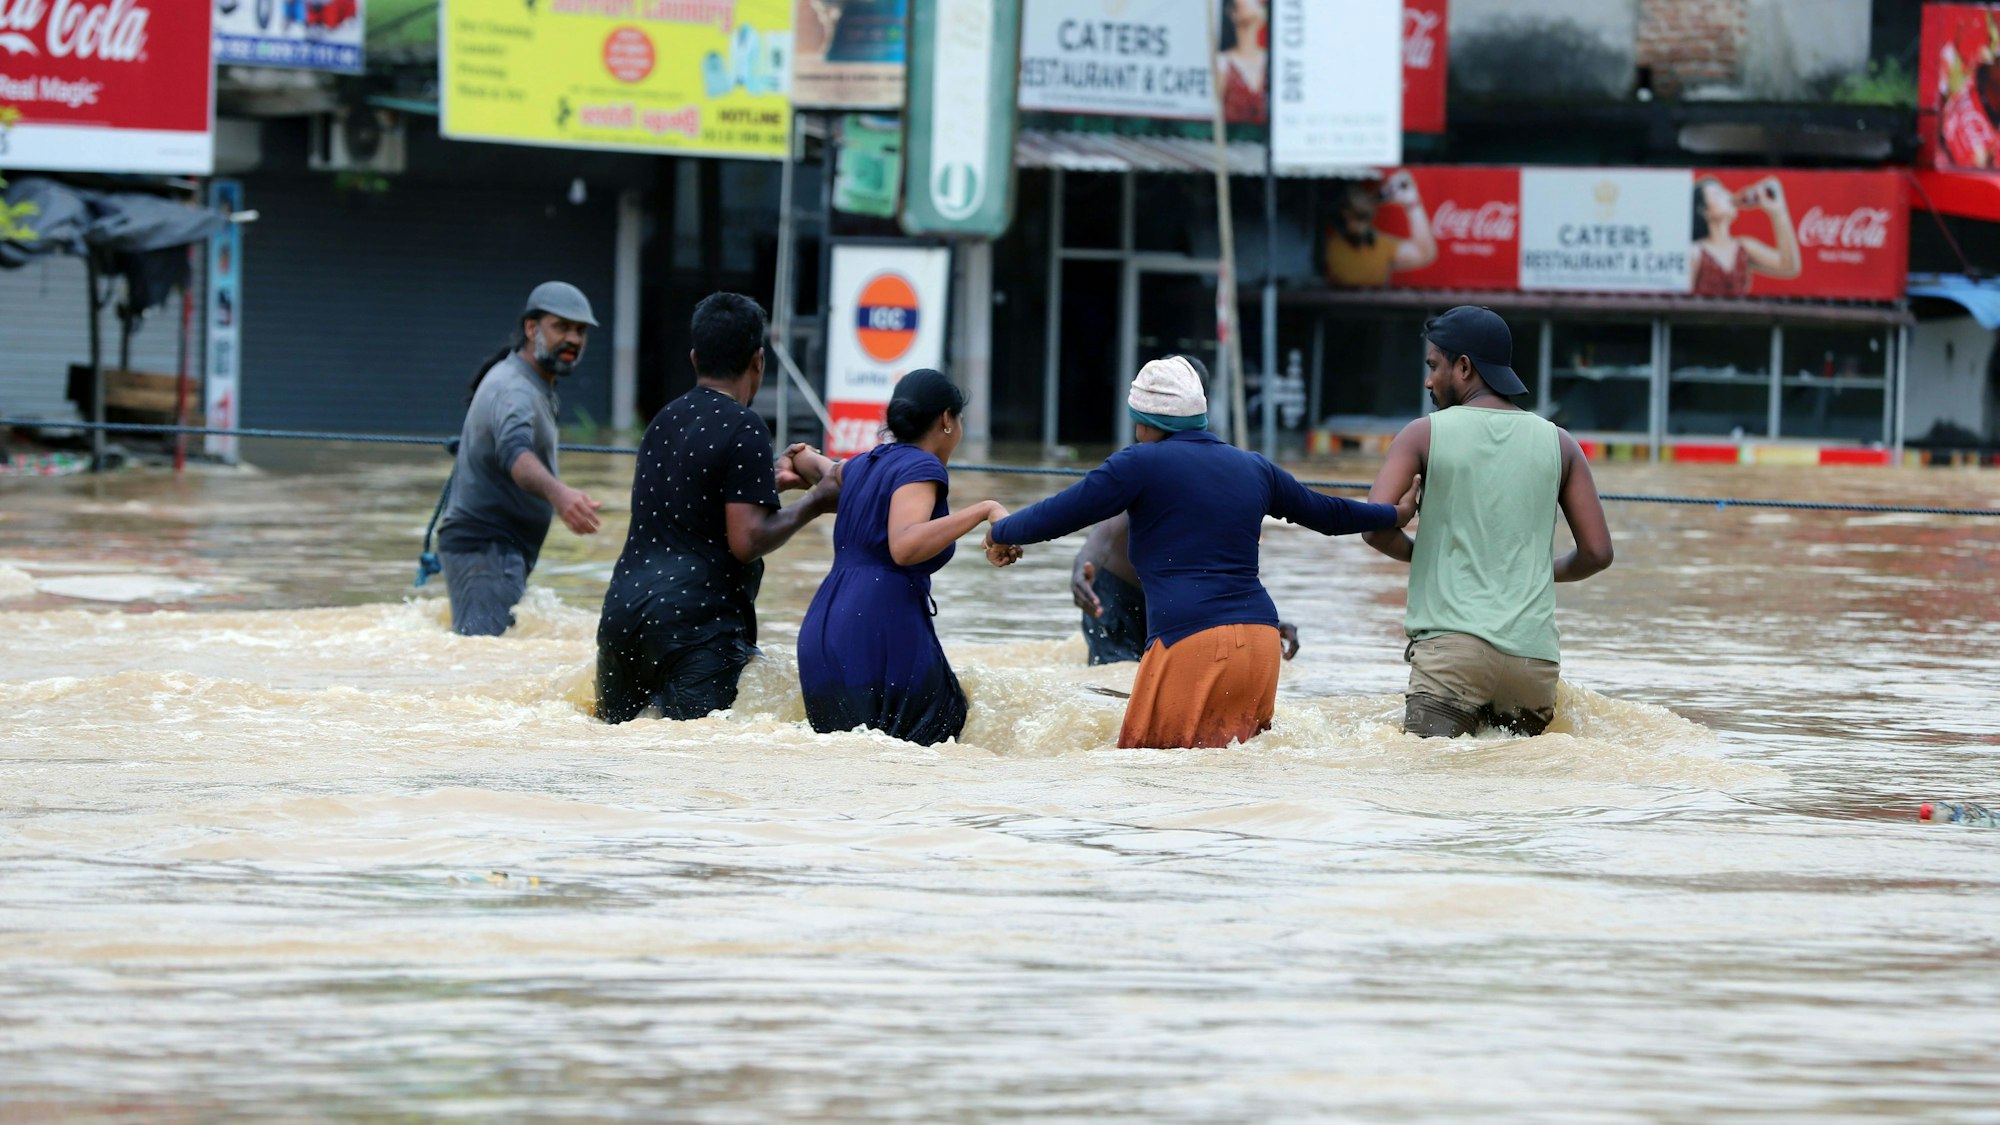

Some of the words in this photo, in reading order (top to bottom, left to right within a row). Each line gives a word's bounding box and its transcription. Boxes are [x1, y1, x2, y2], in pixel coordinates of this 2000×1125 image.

[1056, 18, 1168, 56] CATERS
[1022, 57, 1137, 90] ESTAURANT
[1159, 66, 1209, 97] CAFE
[1282, 57, 1304, 103] DRY
[1557, 223, 1652, 248] CATERS
[1524, 251, 1626, 271] RESTAURANT
[1645, 253, 1686, 273] CAFE
